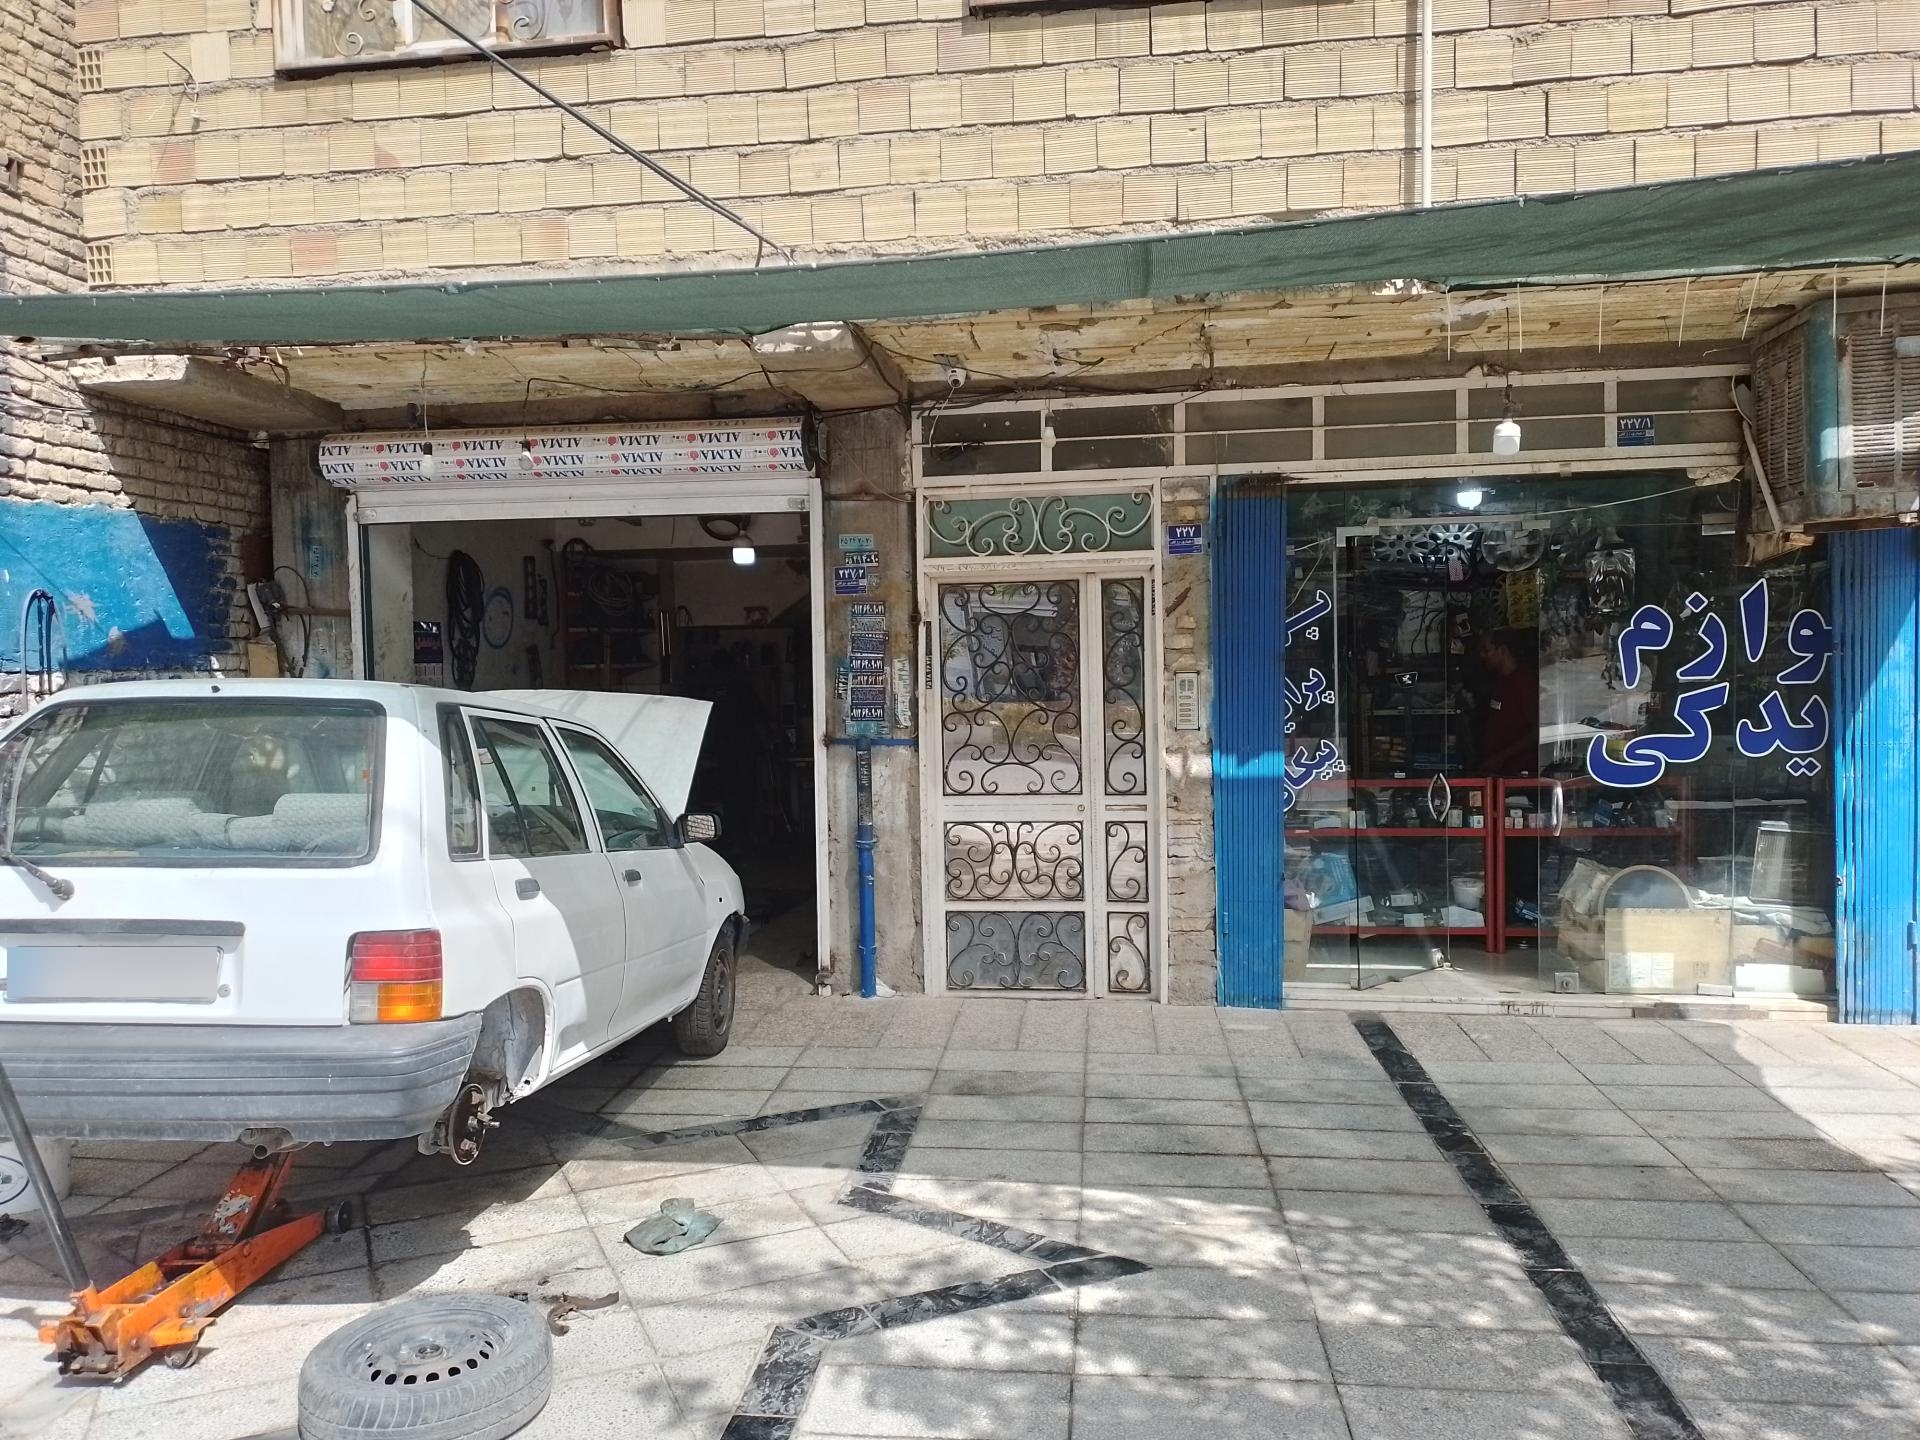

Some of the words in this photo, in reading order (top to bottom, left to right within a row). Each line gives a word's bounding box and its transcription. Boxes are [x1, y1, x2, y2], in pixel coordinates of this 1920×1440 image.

[619, 434, 661, 446] ALMA
[699, 431, 741, 443] ALMA
[779, 429, 801, 440] MA
[463, 440, 504, 451] ALMA
[540, 437, 582, 448] ALMA
[320, 445, 351, 457] ALM
[621, 451, 663, 463] ALMA
[700, 449, 742, 460] ALMA
[781, 446, 804, 458] MA
[466, 457, 507, 469] ALMA
[543, 454, 584, 465] ALMA
[321, 462, 355, 474] ALM
[390, 460, 423, 472] LMA
[620, 467, 663, 475] ALMA
[700, 464, 741, 473] ALMA
[780, 462, 805, 470] MA
[466, 472, 507, 480] ALMA
[543, 470, 584, 478] ALMA
[1176, 526, 1195, 538] ۲۲۷
[1618, 578, 1834, 688] وازم
[1587, 682, 1831, 788] یدکی
